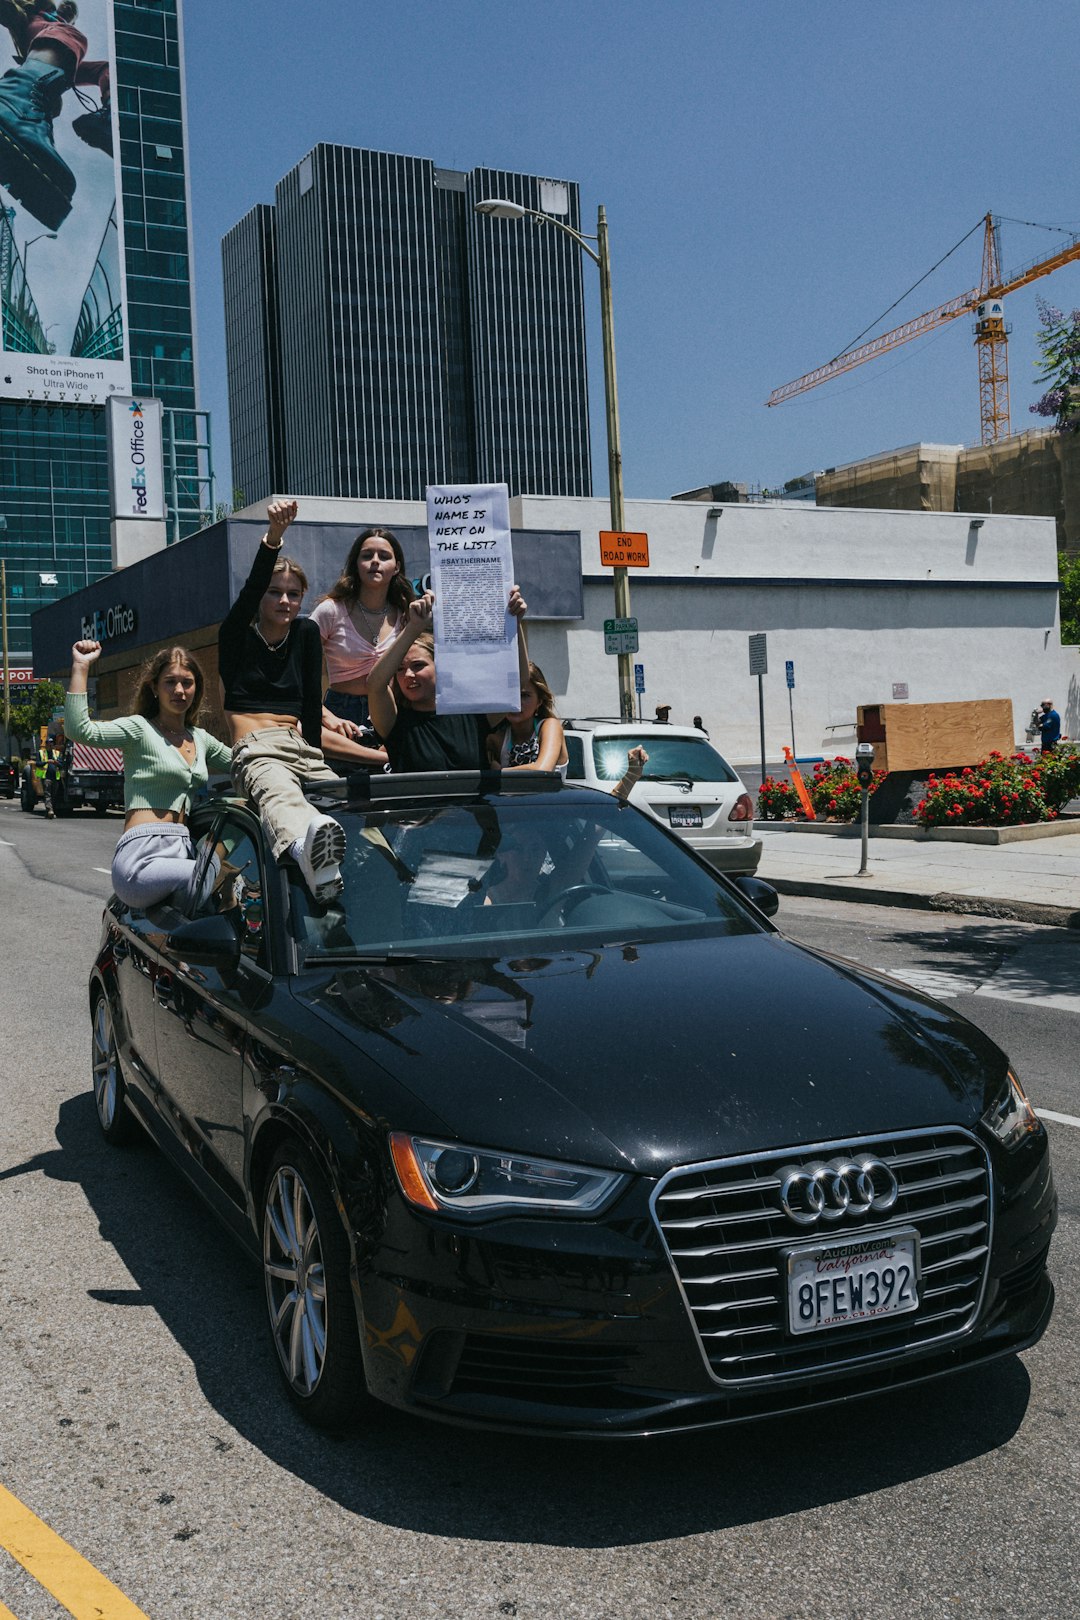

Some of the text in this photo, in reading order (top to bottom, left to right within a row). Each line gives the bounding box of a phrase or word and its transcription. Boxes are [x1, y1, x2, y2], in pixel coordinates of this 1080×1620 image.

[26, 366, 104, 380] Shot on iPhone 11
[43, 379, 89, 390] Ultra Wide
[131, 420, 147, 514] FedEx Office
[434, 495, 471, 505] WHO'S
[435, 510, 486, 520] NAME IS
[436, 526, 485, 536] NEXT ON
[437, 540, 496, 552] THE LIST?
[617, 537, 632, 547] END
[603, 551, 647, 562] ROAD WORK
[81, 605, 134, 641] FedEx Office
[607, 622, 612, 630] 2
[822, 1241, 891, 1260] AudiMV.com
[816, 1249, 894, 1274] California
[798, 1265, 911, 1321] 8FEW392
[824, 1305, 890, 1324] dmv.ca.gov
